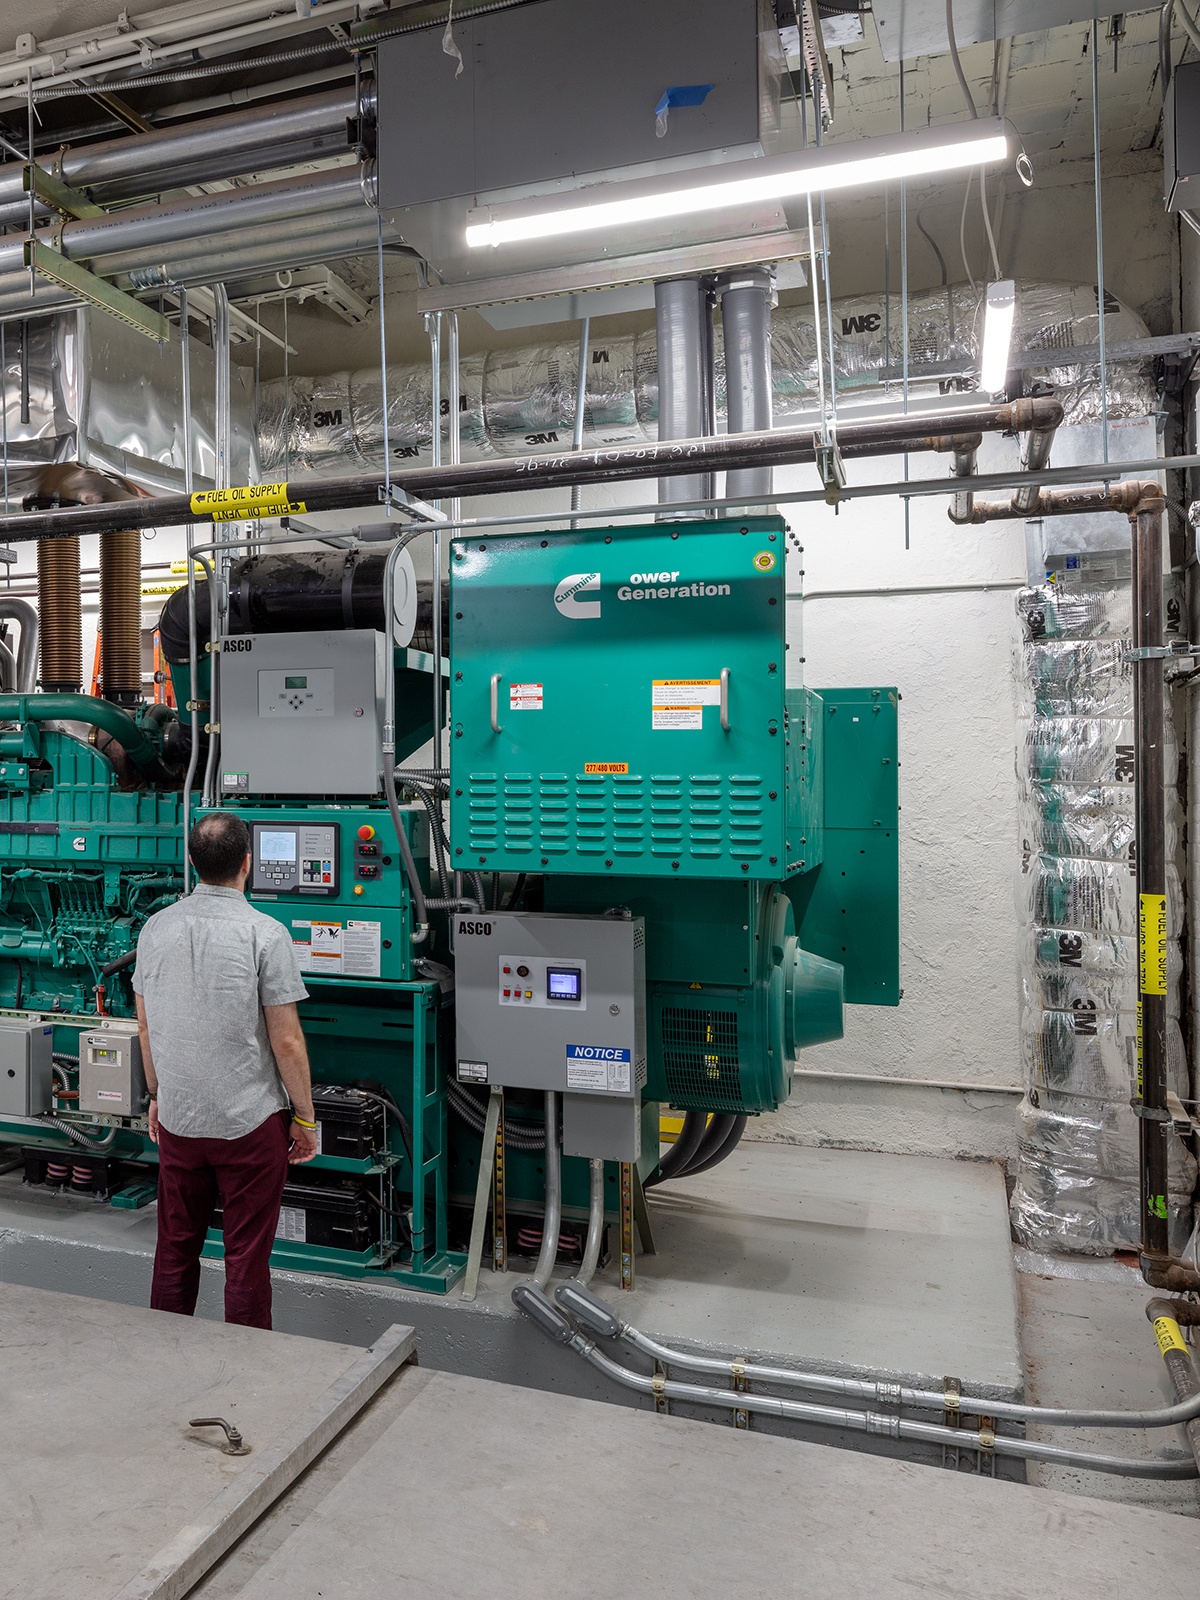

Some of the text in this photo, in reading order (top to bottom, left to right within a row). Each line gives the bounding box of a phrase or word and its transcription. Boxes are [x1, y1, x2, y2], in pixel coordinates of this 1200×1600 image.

[842, 312, 880, 336] 3M
[314, 409, 342, 428] 3M
[524, 432, 560, 446] 3M
[208, 484, 283, 503] FUEL OIL SUPPLY
[629, 570, 680, 584] ower
[555, 572, 596, 604] Cummins
[617, 582, 730, 601] Generation
[1167, 598, 1181, 632] 3M
[223, 640, 252, 652] ASCO
[608, 764, 626, 772] VOLTS
[458, 921, 492, 936] ASCO
[1058, 933, 1082, 968] 3M
[1158, 912, 1167, 991] FUEL OIL SUPPLY
[1072, 998, 1098, 1036] 3M
[574, 1046, 624, 1060] NOTICE
